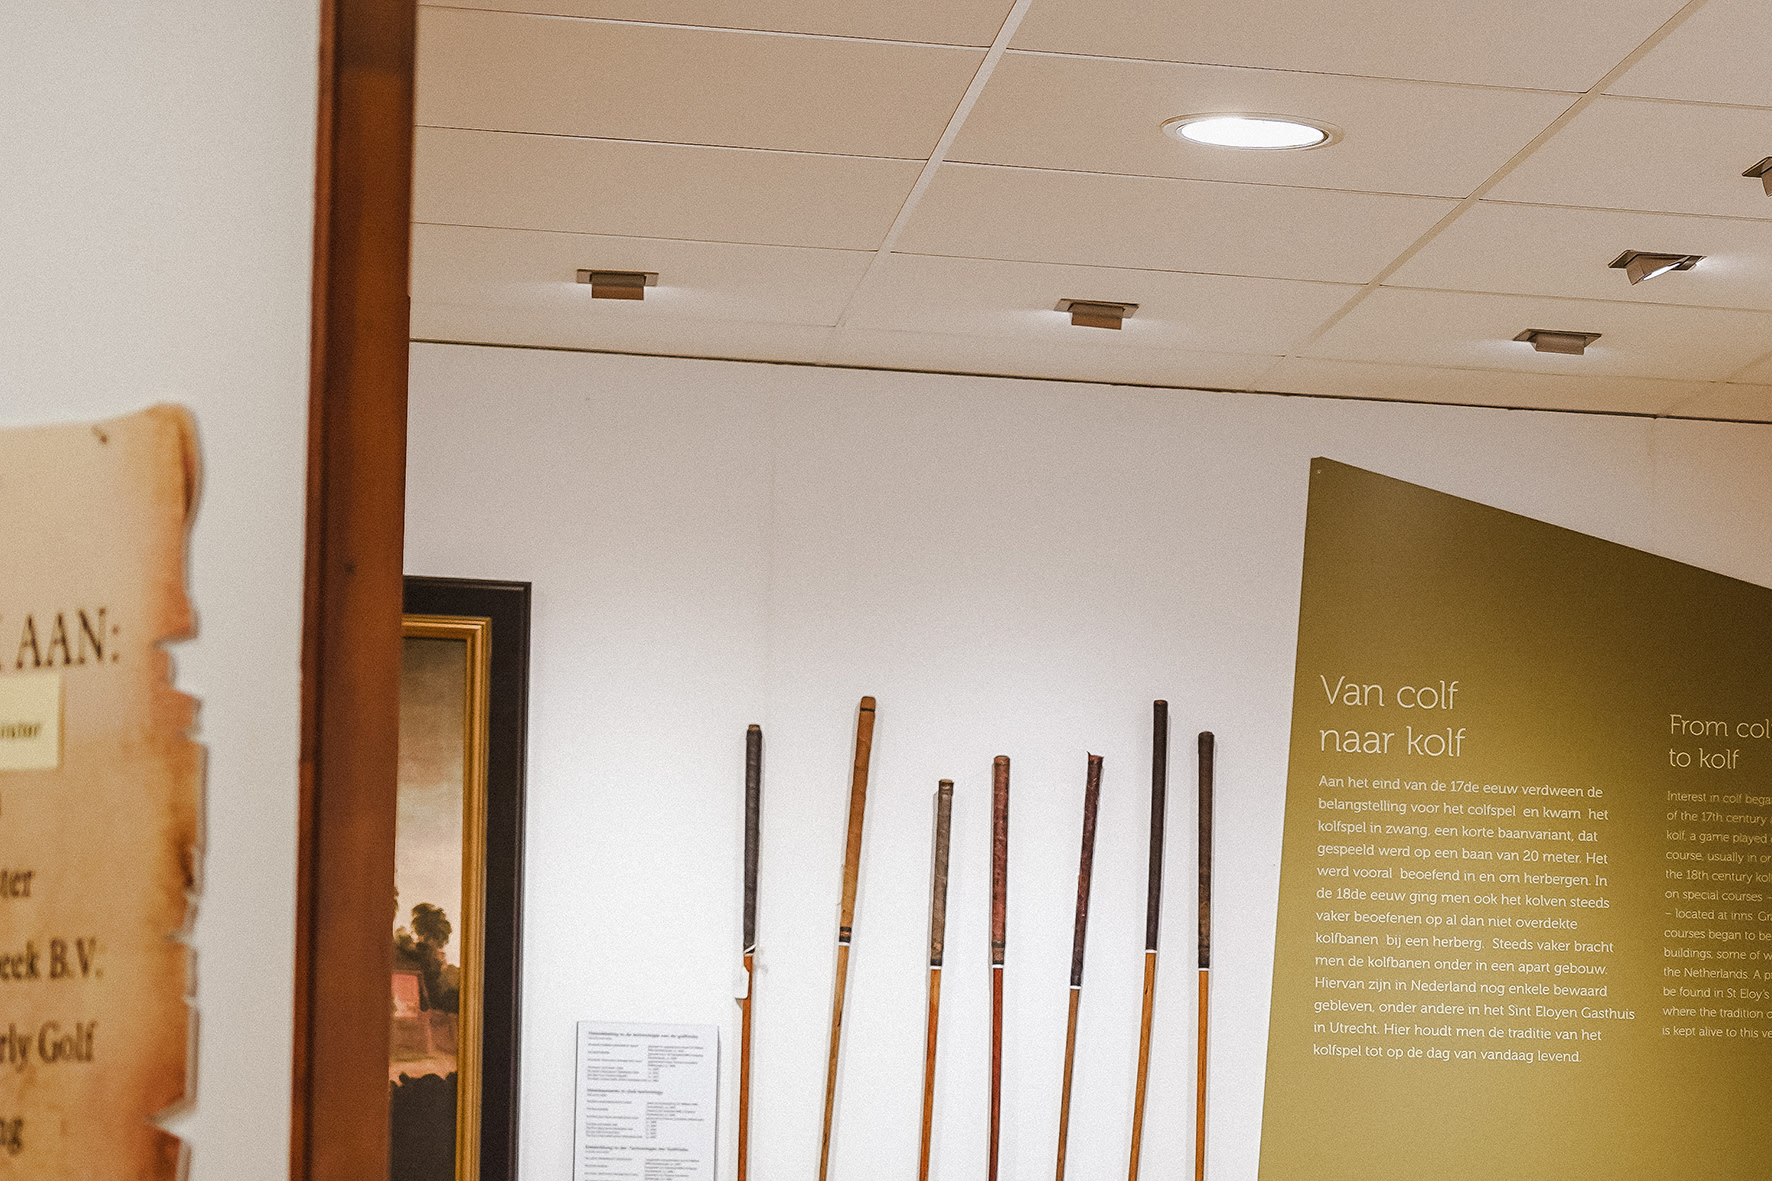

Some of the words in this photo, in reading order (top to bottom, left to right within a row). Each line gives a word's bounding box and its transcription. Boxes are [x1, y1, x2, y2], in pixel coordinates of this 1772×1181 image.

[16, 606, 120, 669] AAN:
[1320, 674, 1384, 706] Van
[1396, 680, 1458, 709] colf
[1670, 714, 1728, 736] From
[1320, 730, 1394, 753] naar
[1406, 725, 1466, 756] kolf
[1668, 749, 1692, 767] to
[1698, 748, 1740, 769] kolf
[1318, 775, 1344, 787] Aan
[1348, 776, 1368, 788] het
[1372, 778, 1400, 789] eind
[1404, 781, 1428, 790] van
[1430, 780, 1446, 791] de
[1450, 780, 1480, 792] 17de
[1482, 784, 1518, 794] eeuw
[1522, 784, 1584, 796] verdween
[1586, 786, 1604, 797] de
[1318, 798, 1406, 814] belangstelling
[1410, 804, 1440, 813] voor
[1444, 803, 1464, 814] het
[1468, 804, 1516, 818] colfspel
[1522, 808, 1540, 817] en
[1542, 806, 1580, 818] kwam
[1588, 808, 1608, 820] het
[1666, 810, 1678, 820] of
[1680, 811, 1698, 820] the
[1702, 811, 1722, 821] 17th
[1726, 814, 1766, 826] century
[1666, 869, 1682, 879] the
[1686, 869, 1708, 880] 18th
[1712, 872, 1752, 884] century
[1316, 887, 1332, 898] de
[1336, 888, 1366, 899] 18de
[1370, 892, 1406, 901] eeuw
[1410, 893, 1438, 905] ging
[1442, 894, 1470, 903] men
[1474, 893, 1498, 904] ook
[1502, 894, 1520, 905] het
[1526, 895, 1566, 906] kolven
[1570, 896, 1610, 908] steeds
[1316, 932, 1378, 944] kolfbanen
[1386, 934, 1402, 948] bij
[1404, 937, 1428, 946] een
[1432, 936, 1485, 950] herberg.
[1492, 938, 1534, 950] Steeds
[1536, 939, 1570, 951] vaker
[1574, 941, 1614, 953] bracht
[1664, 930, 1706, 938] courses
[1708, 929, 1742, 942] began
[1744, 932, 1756, 941] to
[1758, 931, 1772, 941] be
[1314, 977, 1364, 989] Hiervan
[1368, 981, 1392, 992] zijn
[1396, 980, 1406, 990] in
[1410, 979, 1476, 992] Nederland
[1480, 984, 1506, 996] nog
[1508, 983, 1550, 995] enkele
[1554, 984, 1608, 996] bewaard
[1314, 999, 1374, 1014] gebleven,
[1378, 1001, 1416, 1013] onder
[1420, 1002, 1464, 1014] andere
[1468, 1004, 1480, 1015] in
[1484, 1004, 1504, 1015] het
[1508, 1005, 1532, 1016] Sint
[1536, 1006, 1578, 1020] Eloyen
[1580, 1007, 1636, 1019] Gasthuis
[38, 1019, 97, 1064] Golf
[1314, 1044, 1362, 1058] kolfspel
[1366, 1045, 1382, 1056] tot
[1386, 1048, 1404, 1059] op
[1406, 1046, 1424, 1058] de
[1426, 1047, 1450, 1061] dag
[1454, 1050, 1476, 1059] van
[1480, 1048, 1534, 1063] vandaag
[1538, 1050, 1583, 1061] levend.
